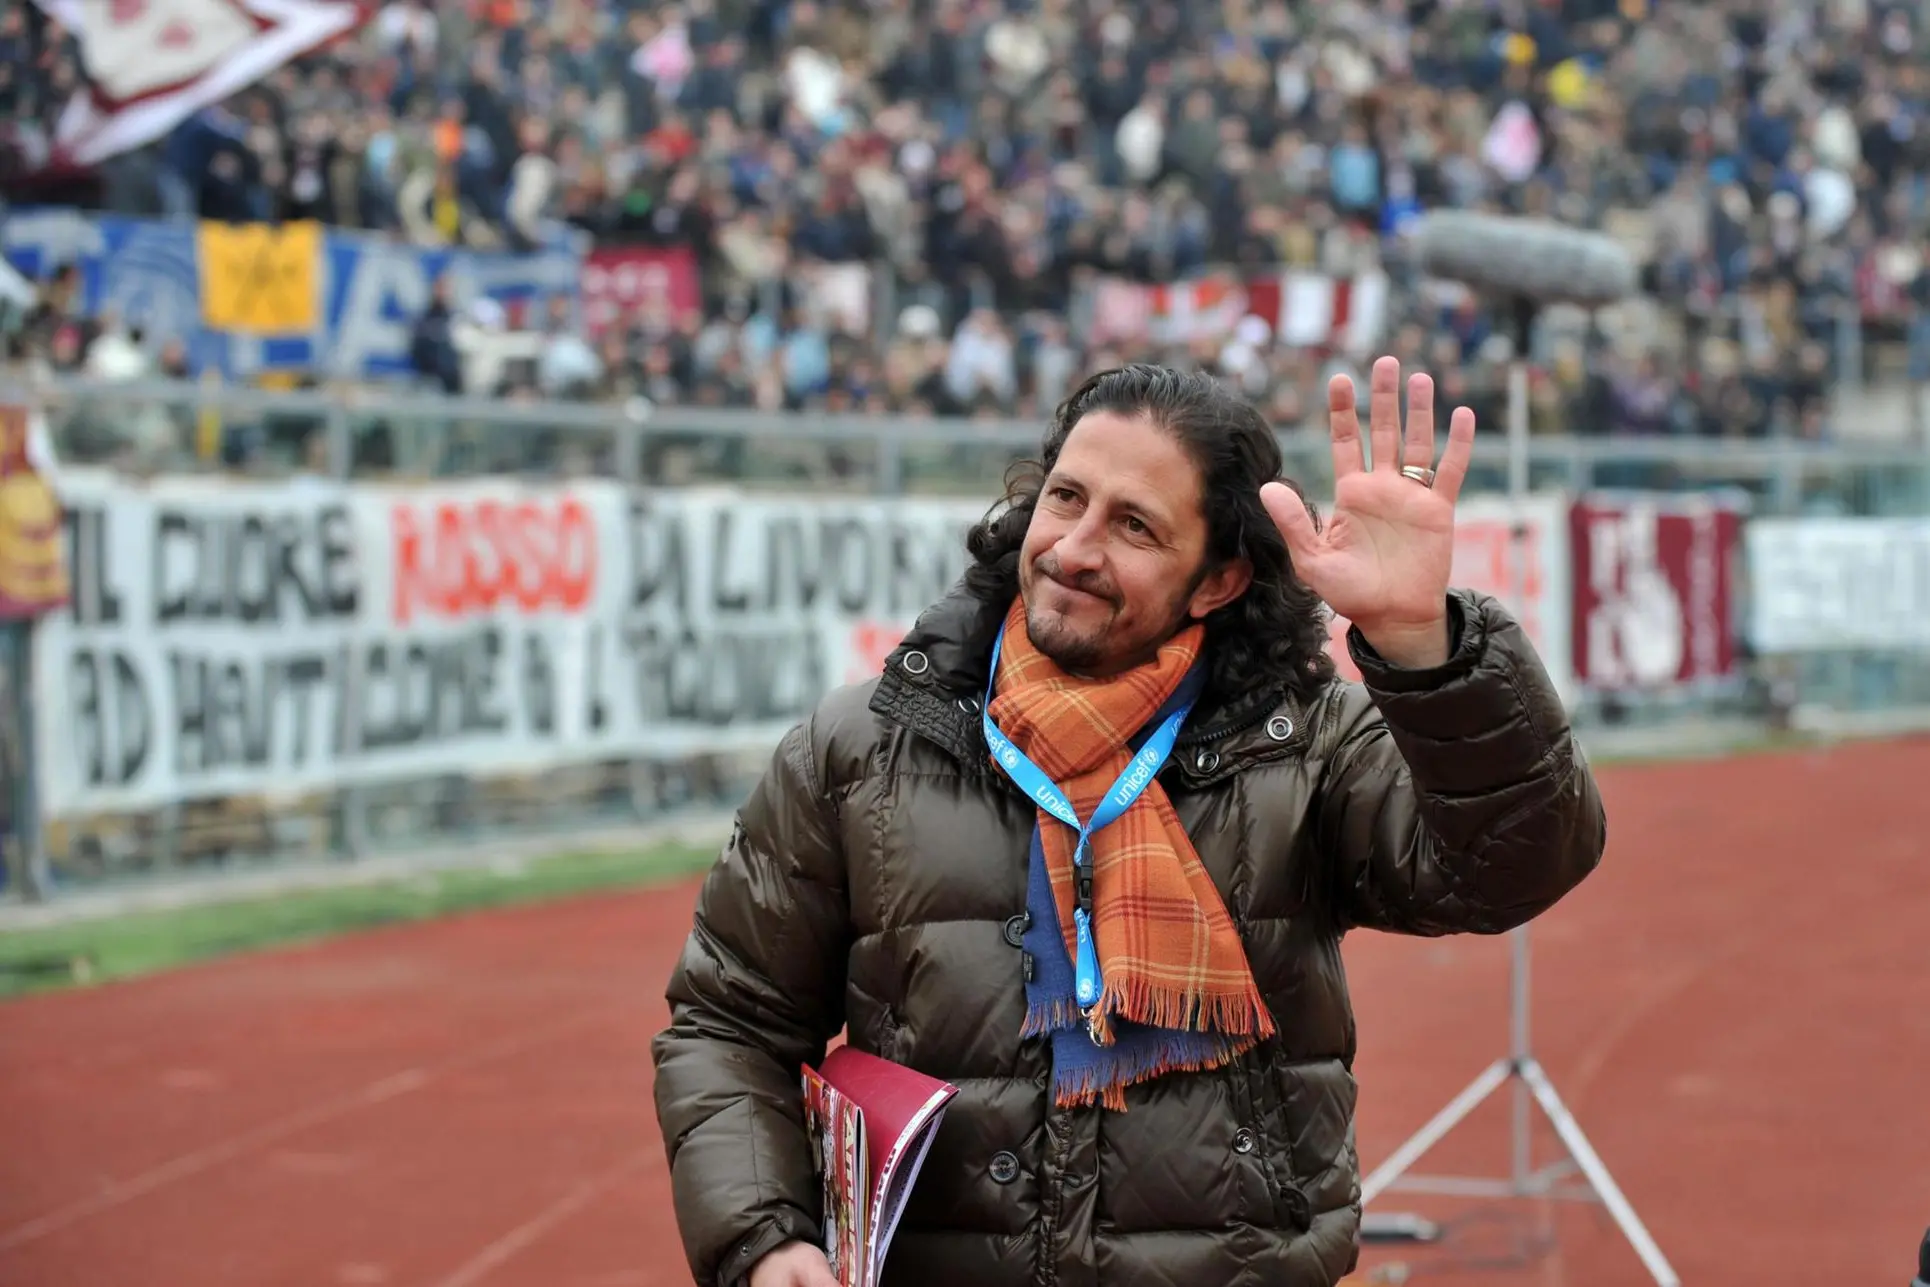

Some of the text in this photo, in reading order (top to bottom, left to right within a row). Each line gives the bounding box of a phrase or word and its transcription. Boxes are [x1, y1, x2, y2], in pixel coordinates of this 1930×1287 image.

[153, 502, 359, 622] CUORE
[392, 492, 599, 626] ROSSO
[1114, 757, 1151, 806] unicef
